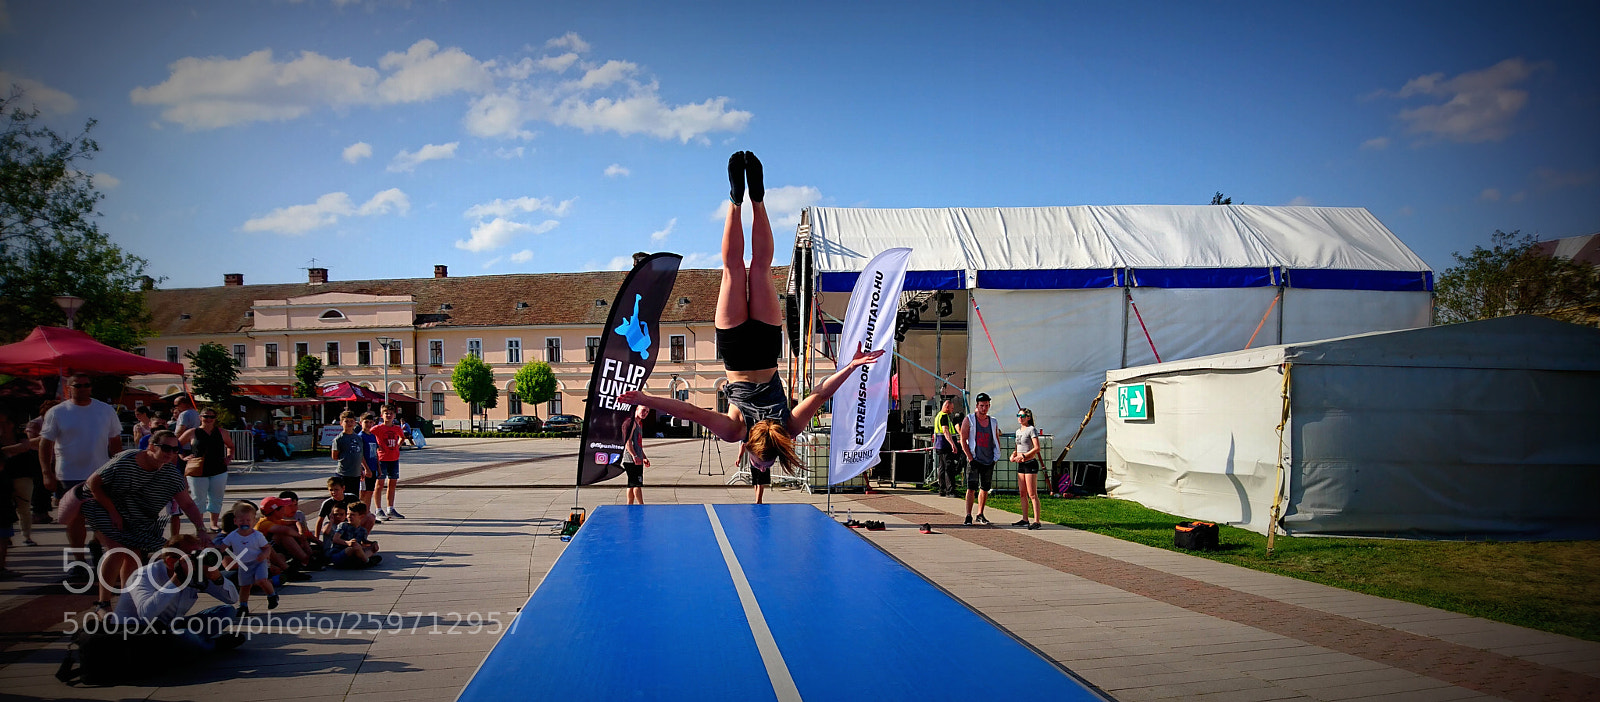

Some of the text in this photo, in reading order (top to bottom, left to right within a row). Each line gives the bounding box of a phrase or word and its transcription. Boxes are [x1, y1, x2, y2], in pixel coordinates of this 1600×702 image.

[602, 358, 646, 384] FLIP
[855, 270, 884, 446] EXTREMSPORBEMUTATO.HU
[844, 449, 873, 459] FLIPUNIT
